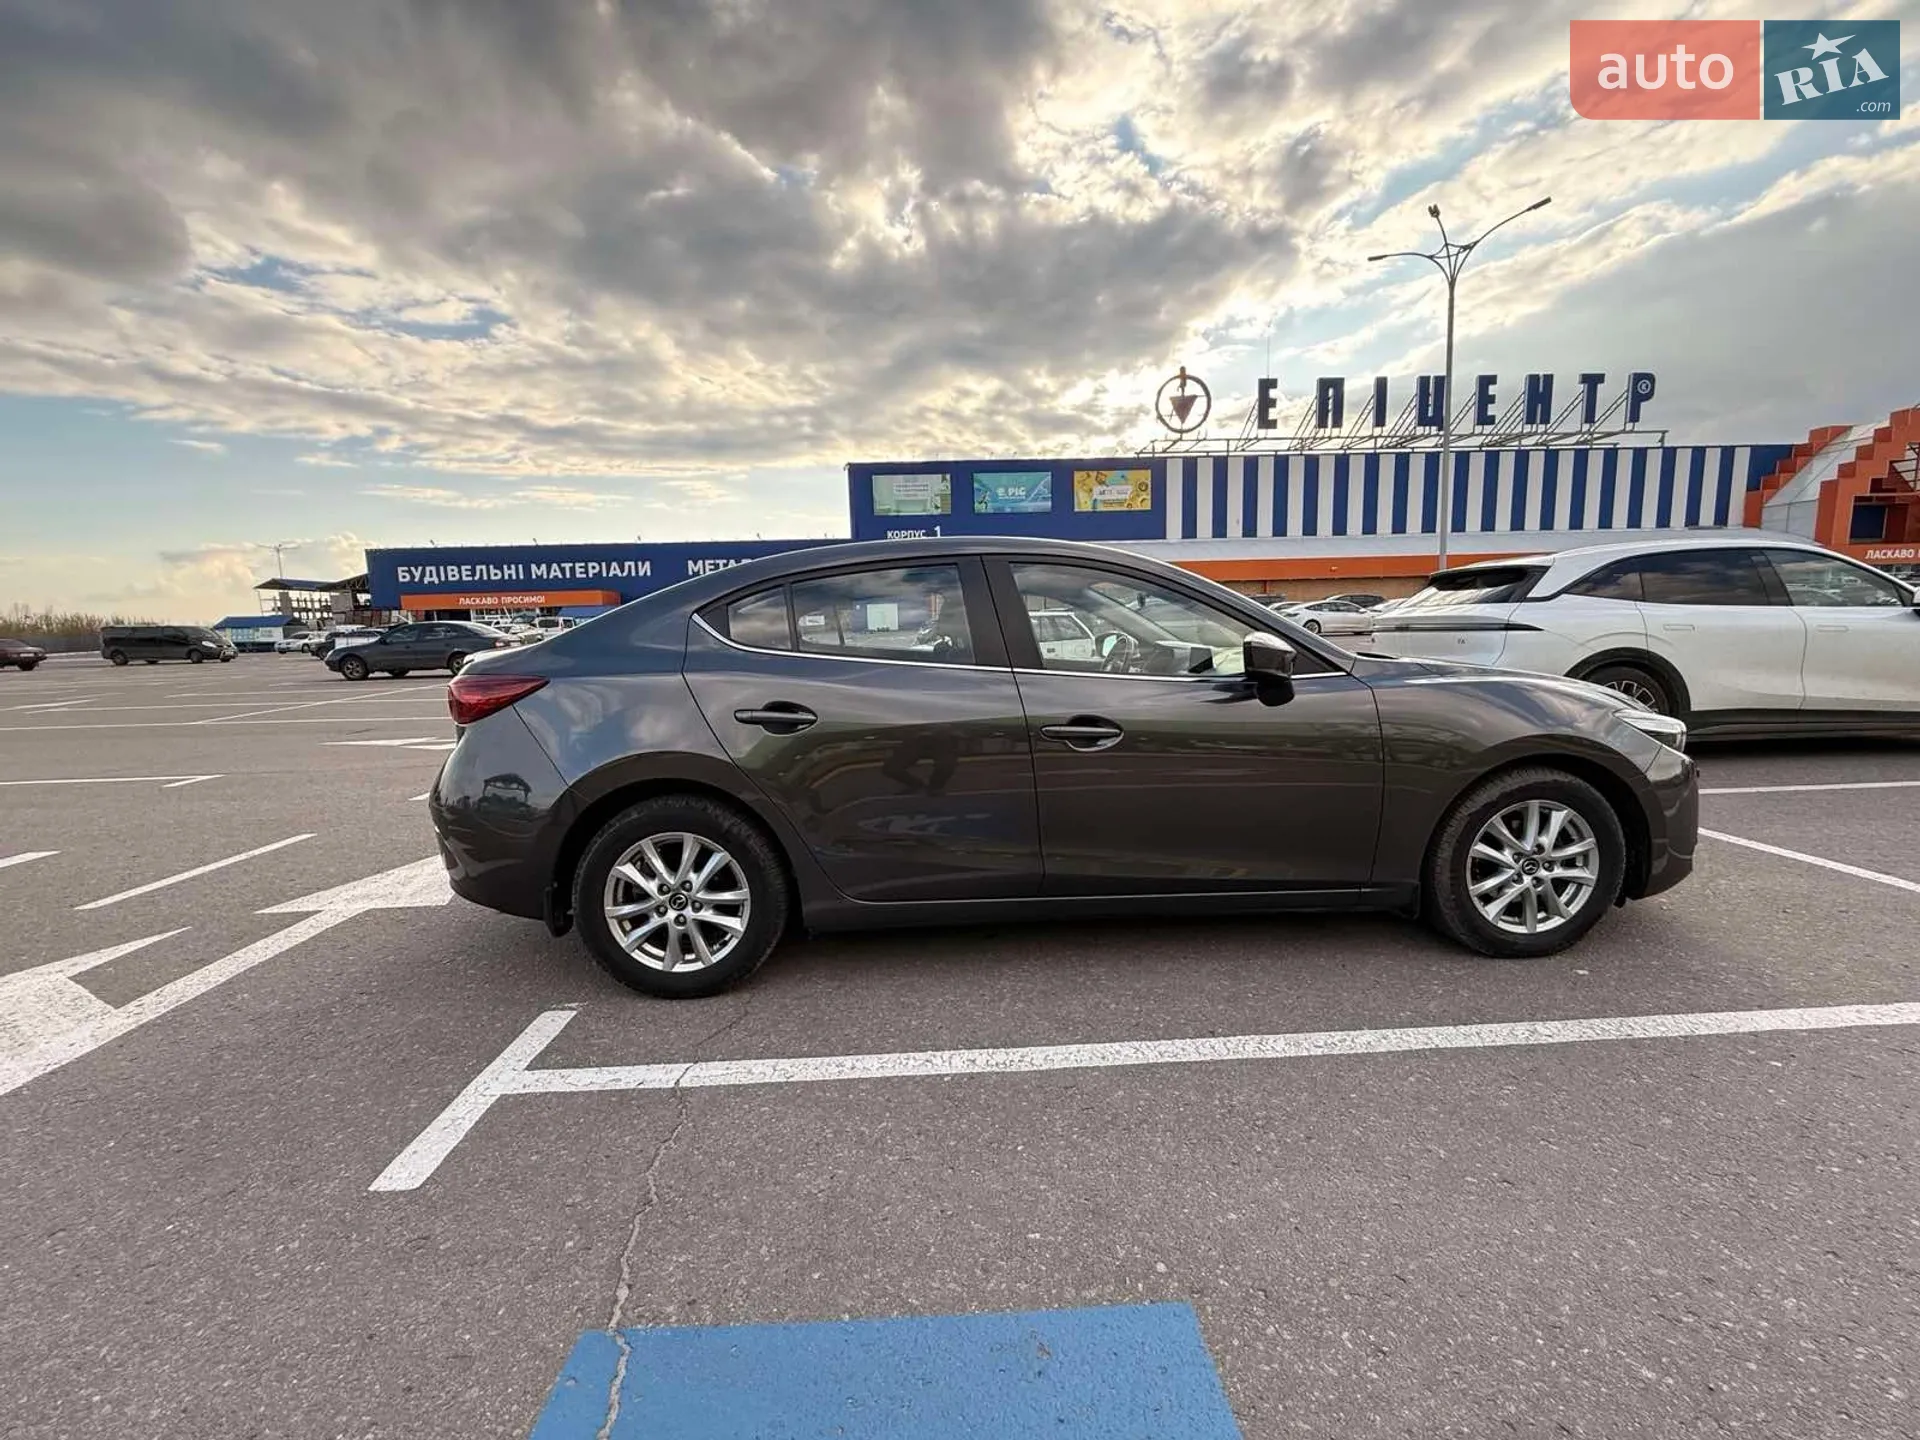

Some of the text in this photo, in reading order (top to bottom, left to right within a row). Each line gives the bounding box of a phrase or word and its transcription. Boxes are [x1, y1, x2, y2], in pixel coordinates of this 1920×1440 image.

[1258, 372, 1655, 431] ЕПІЦЕНТР
[887, 526, 941, 539] КОРПУС 1
[1865, 549, 1915, 559] ЛАСКАВО
[397, 561, 652, 584] БУДІВЕЛЬНІ МАТЕРІАЛИ
[459, 595, 545, 605] ЛАСКАВО ПРОСИМО!
